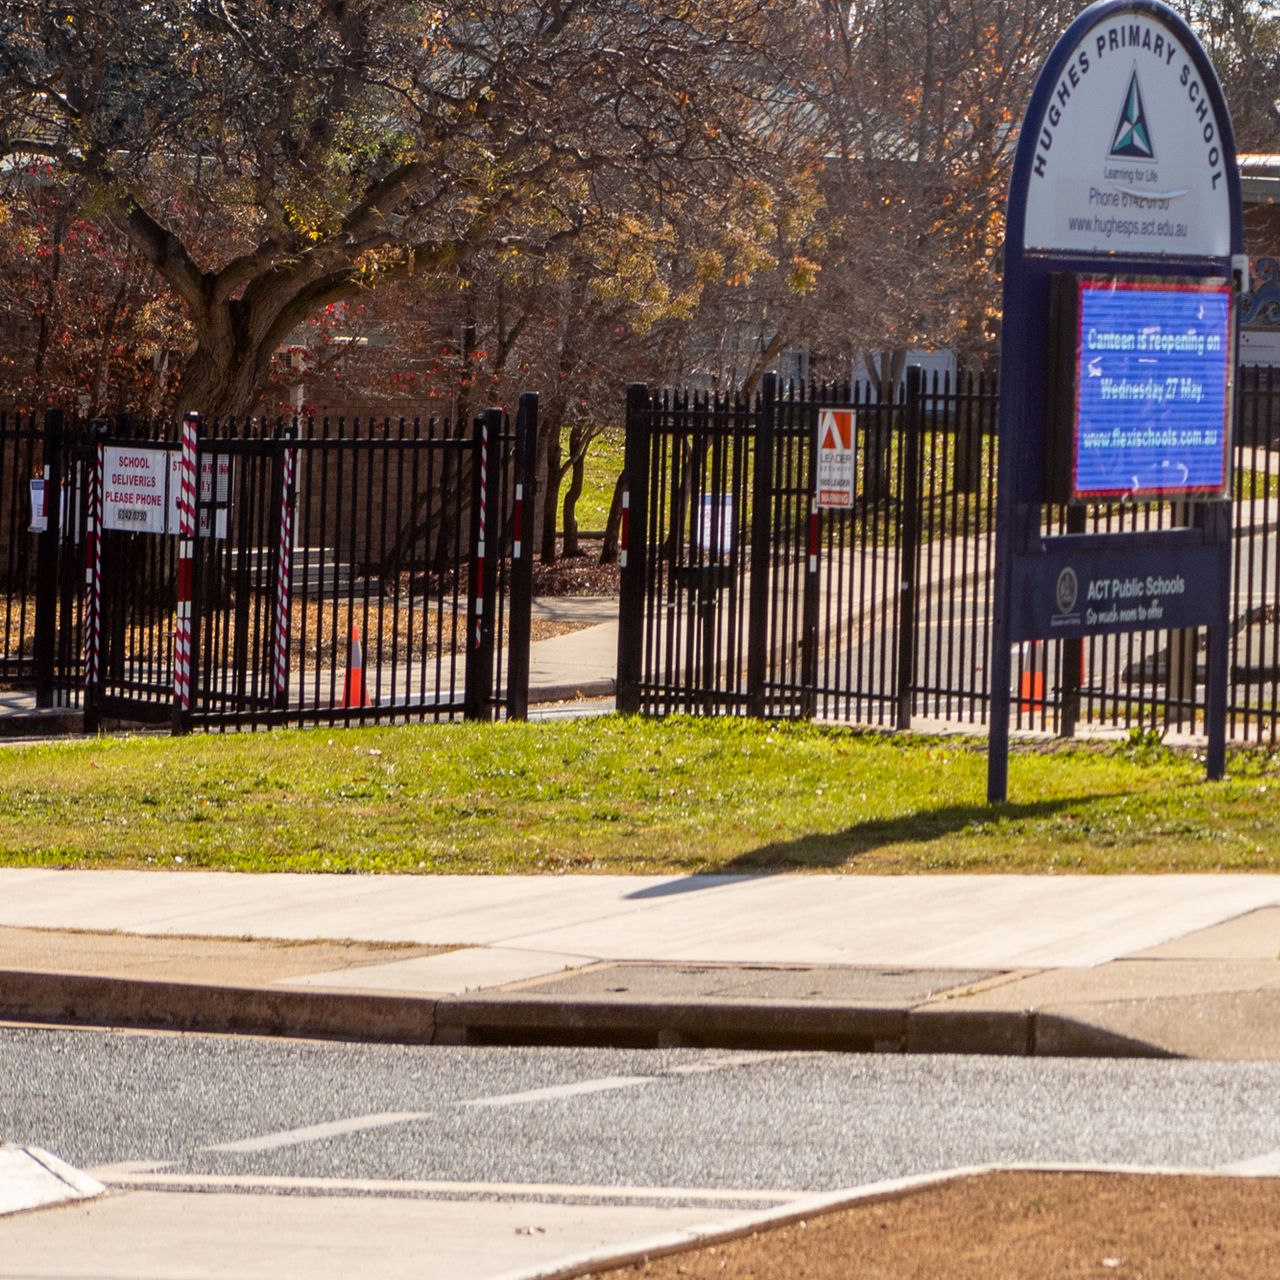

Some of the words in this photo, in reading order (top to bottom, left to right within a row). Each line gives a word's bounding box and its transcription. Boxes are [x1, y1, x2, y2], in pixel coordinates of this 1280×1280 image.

[1033, 51, 1090, 179] HUGHES
[1096, 24, 1176, 66] PRIMARY
[1179, 63, 1222, 191] SCHOOL
[1103, 166, 1134, 184] Learning
[1135, 168, 1144, 182] for
[1145, 168, 1158, 182] Life
[1088, 186, 1120, 207] Phone
[1068, 214, 1188, 239] www.hughesps.act.edu.au
[1087, 327, 1135, 350] Canteen
[1137, 327, 1147, 351] is
[1149, 332, 1205, 356] reopening
[1206, 334, 1221, 351] on
[1100, 377, 1164, 404] Wednesday
[1165, 377, 1179, 400] 27
[1180, 377, 1205, 404] May.
[1082, 426, 1218, 449] www.flexischools.com.au
[118, 455, 150, 469] SCHOOL
[820, 453, 853, 464] LEADER
[111, 473, 157, 488] DELIVERIES
[105, 491, 134, 504] PLEASE
[135, 493, 162, 506] PHONE
[1087, 579, 1110, 601] ACT
[1112, 577, 1145, 600] Public
[1145, 574, 1185, 596] Schools
